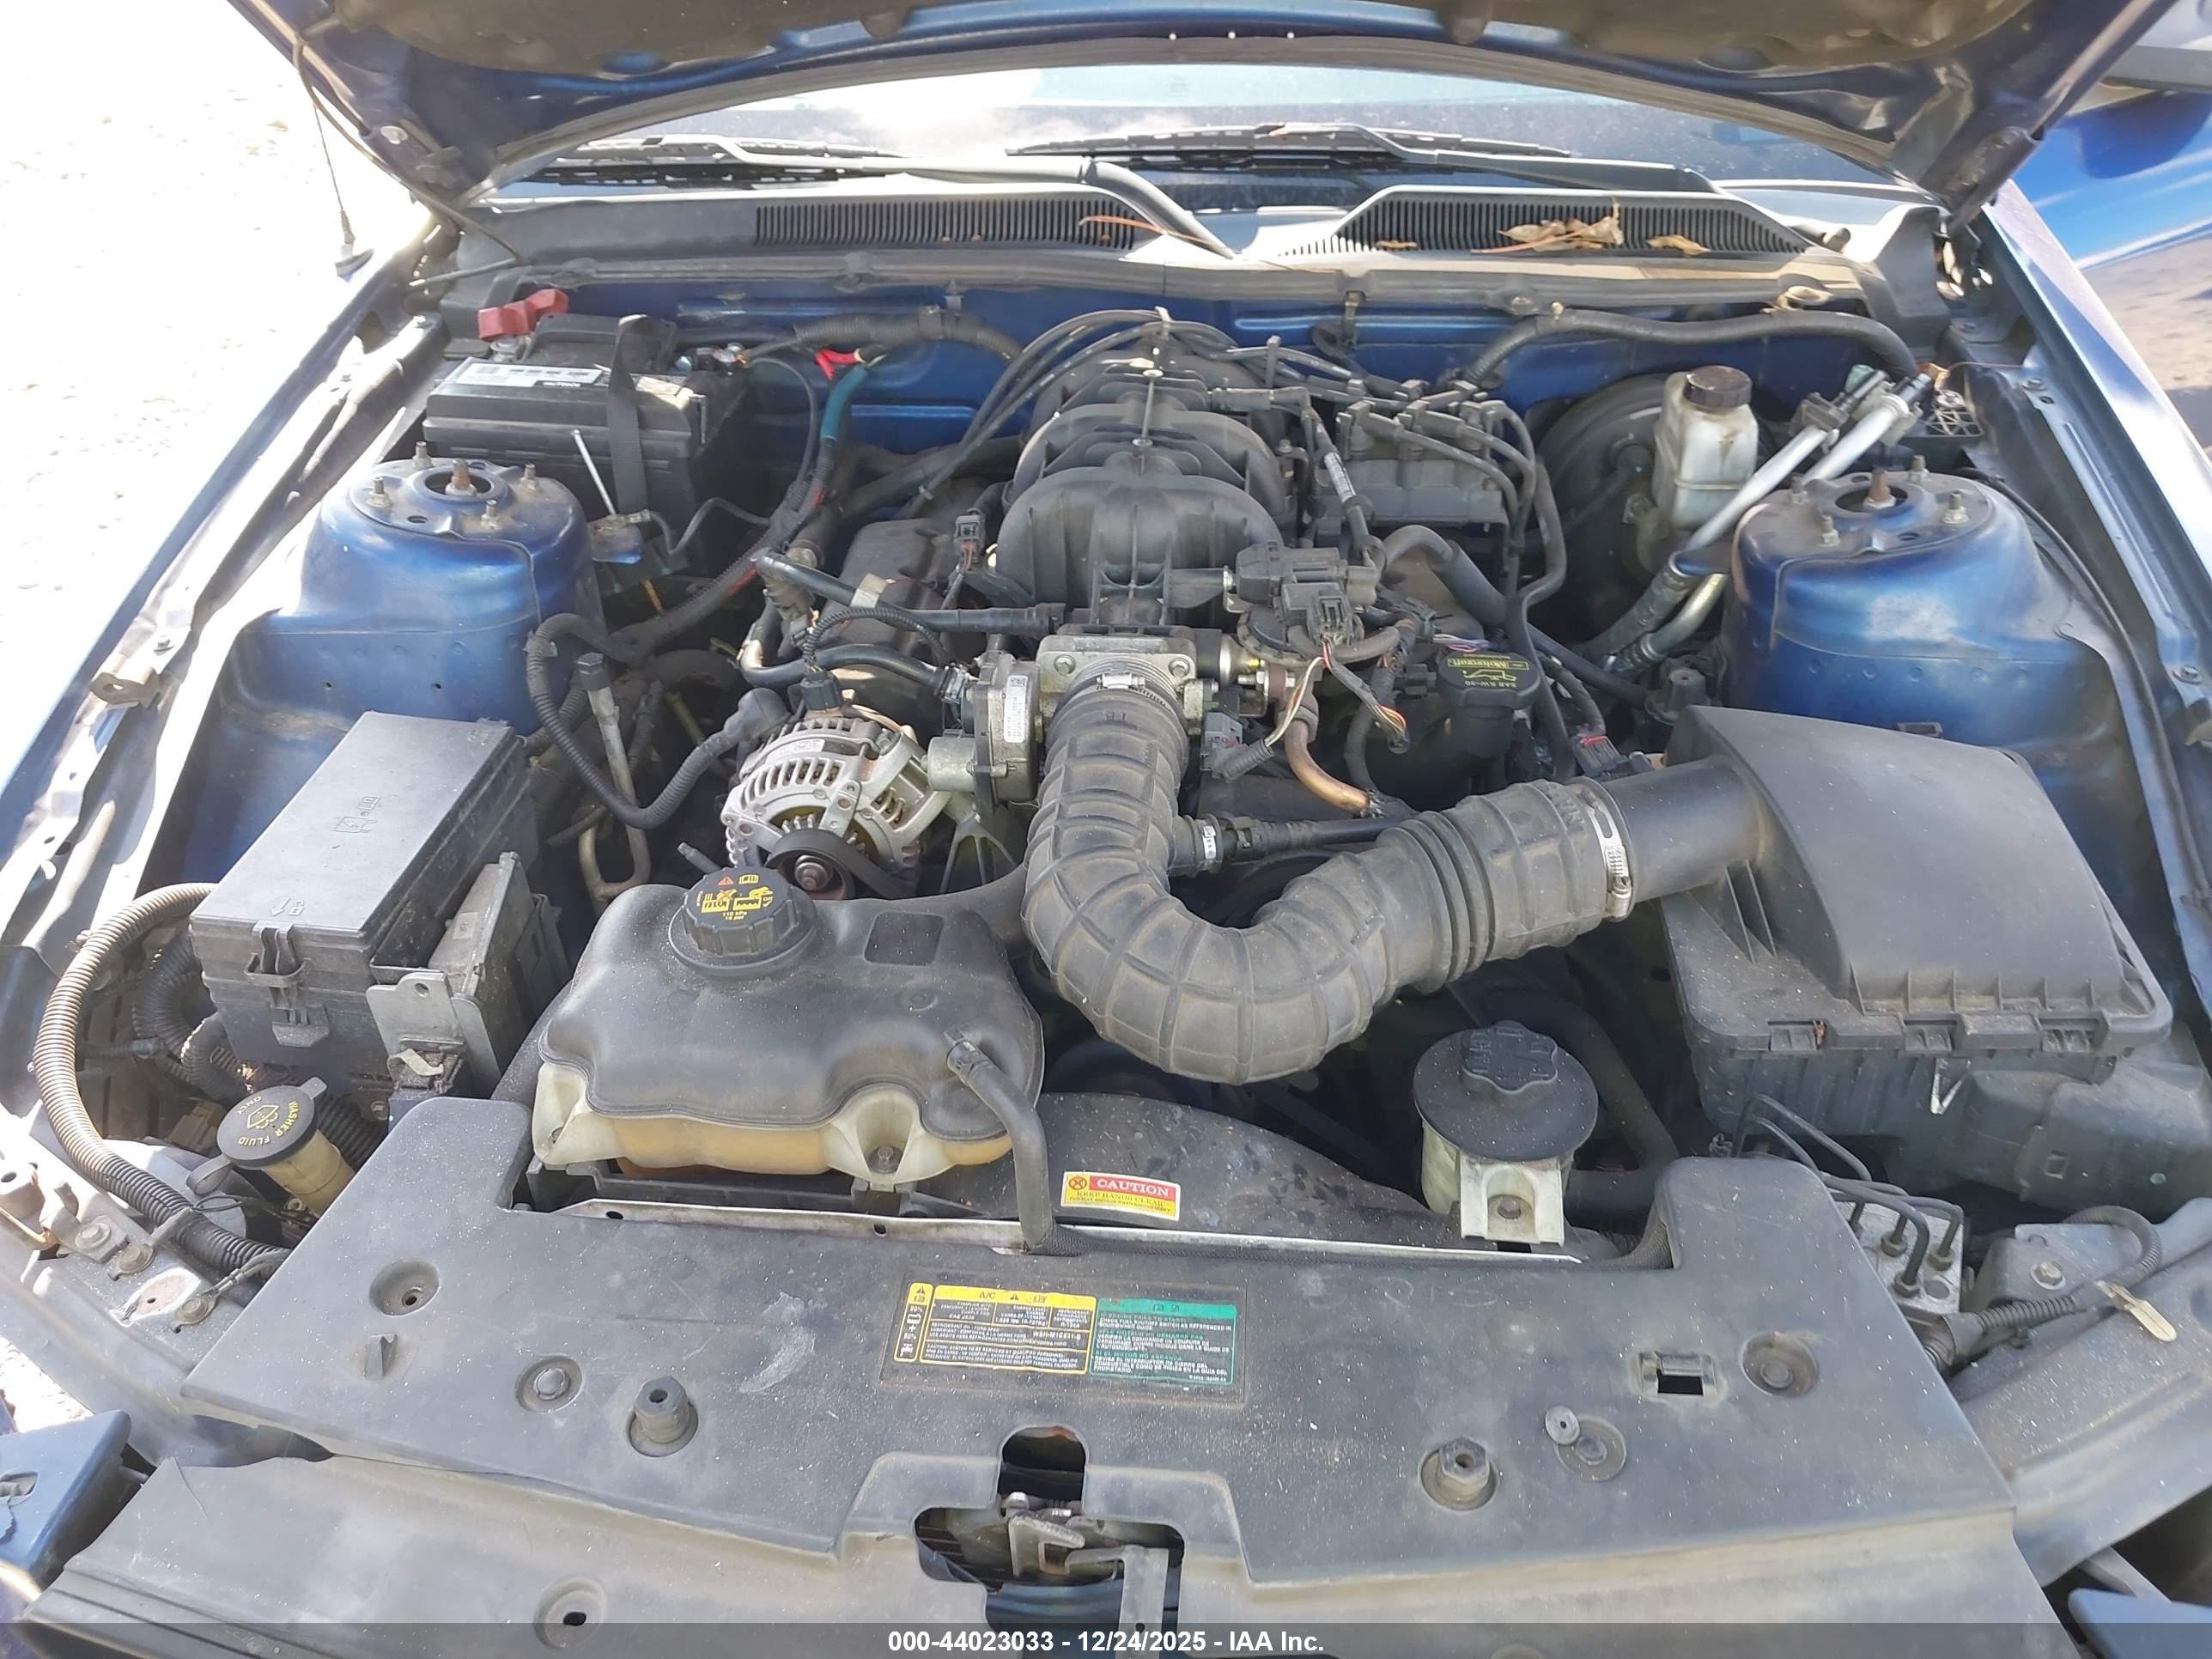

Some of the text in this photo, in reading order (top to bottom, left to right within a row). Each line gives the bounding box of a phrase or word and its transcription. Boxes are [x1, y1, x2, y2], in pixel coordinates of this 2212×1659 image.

[234, 1096, 299, 1146] WASHER FLUID ONLY
[1097, 1178, 1169, 1197] CAUTION
